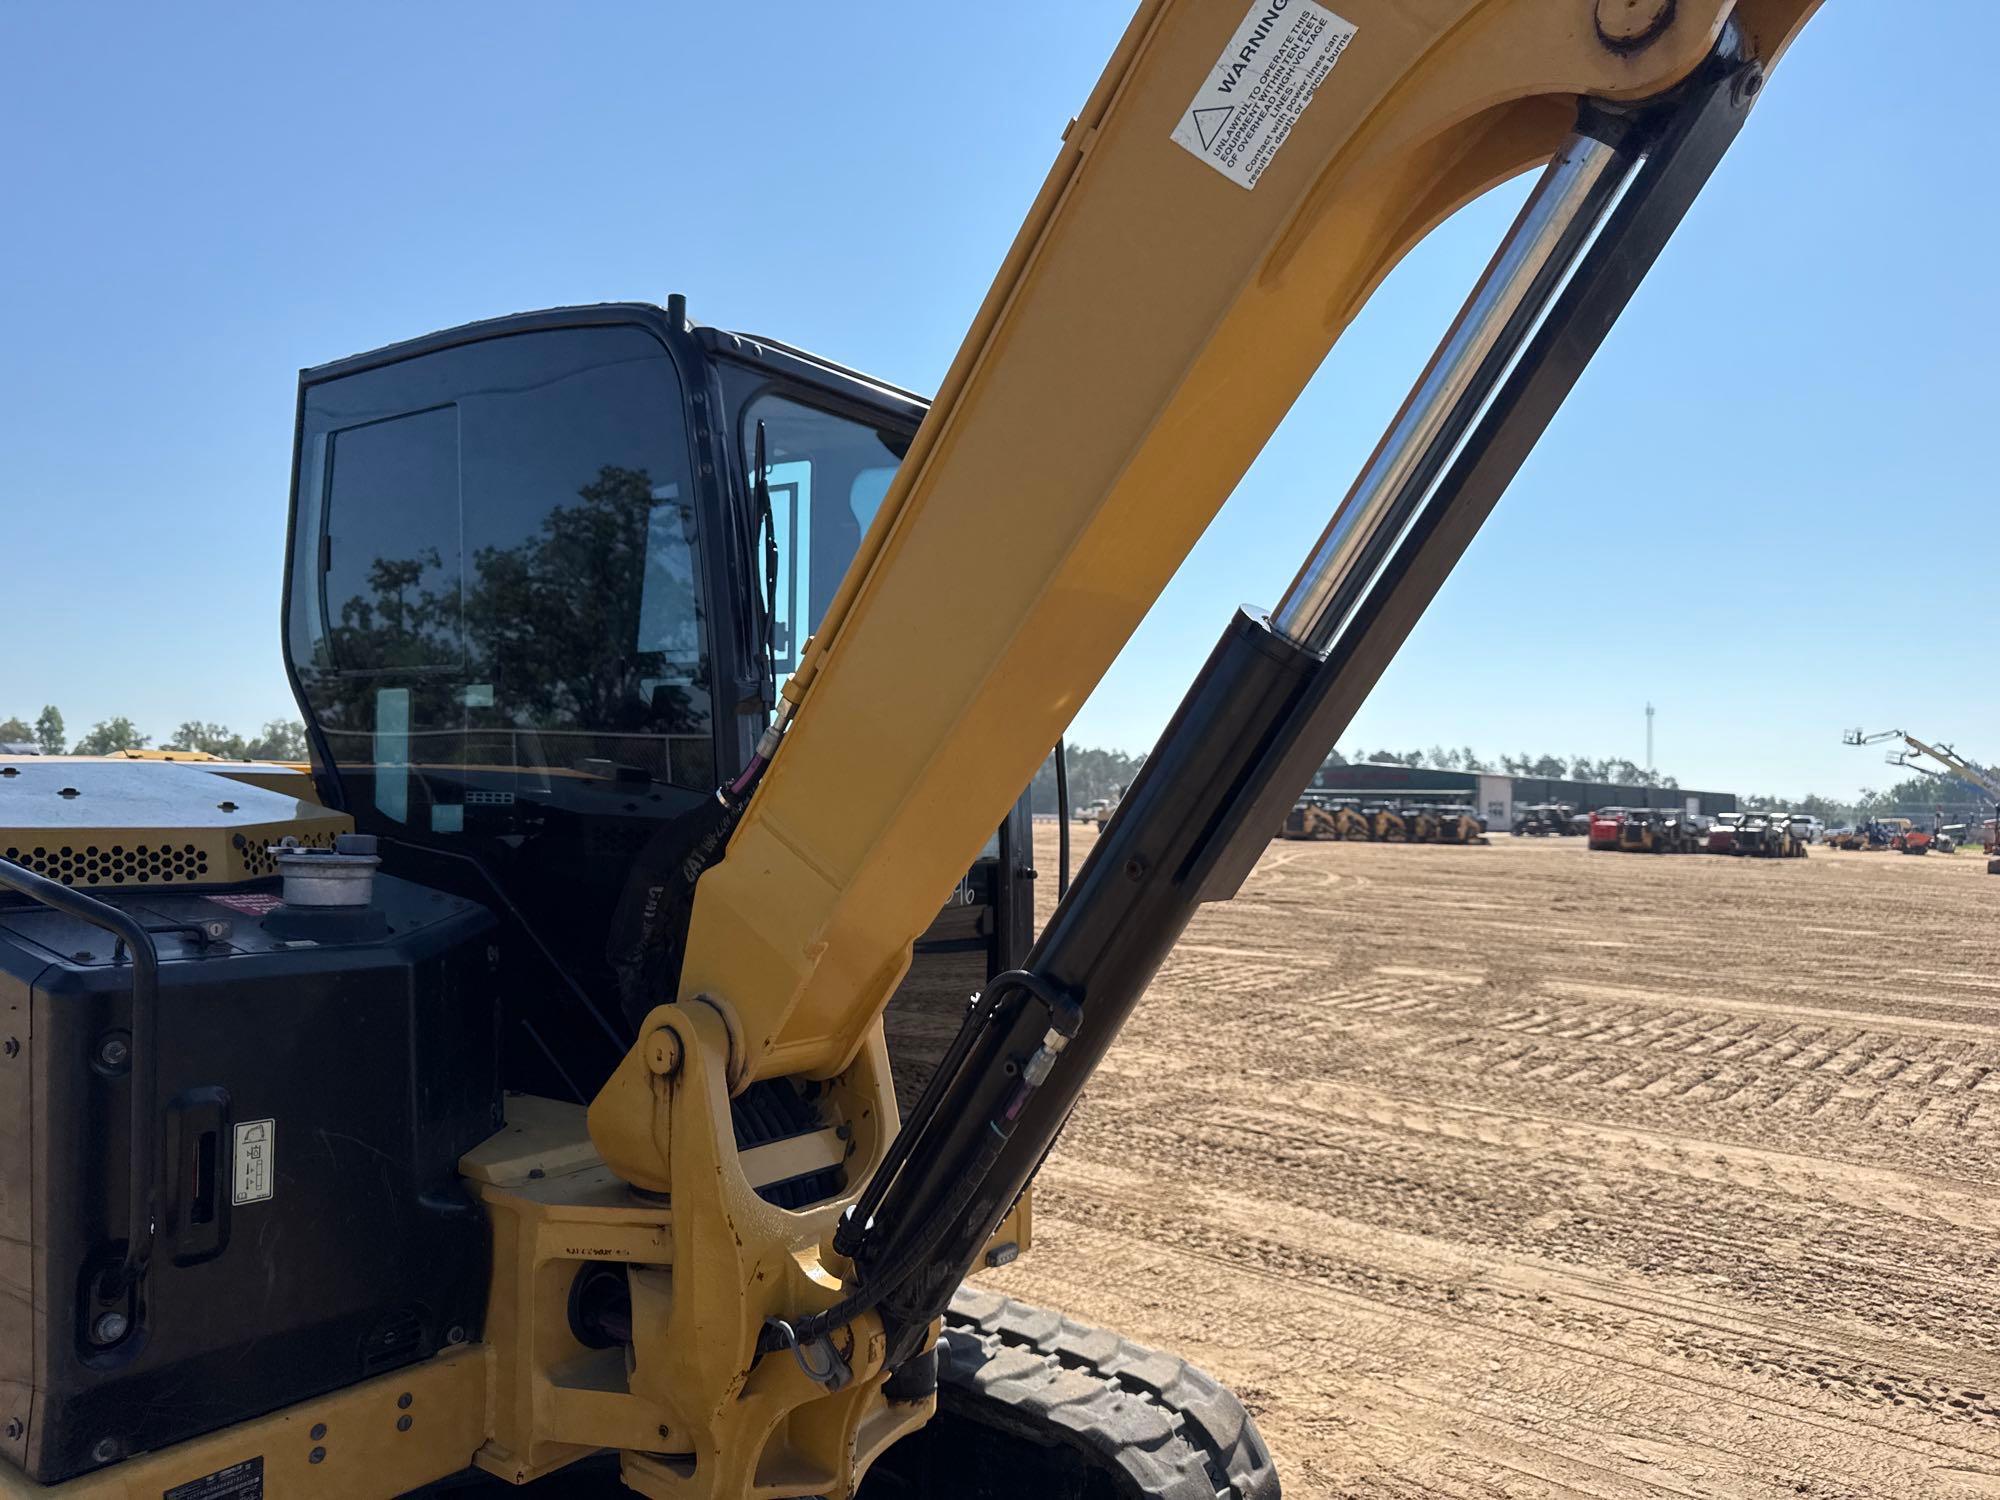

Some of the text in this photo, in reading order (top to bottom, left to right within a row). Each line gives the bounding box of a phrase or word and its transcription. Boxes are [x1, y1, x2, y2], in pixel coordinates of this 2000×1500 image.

[1213, 10, 1310, 156] UNLAWFUL TO OPERATE THIS
[1217, 0, 1288, 94] WARNING
[1220, 14, 1318, 162] EQUIPMENT WITHIN TEN FEET
[1226, 17, 1328, 168] OF OVERHEAD HIGH-VOLTAGE
[1245, 33, 1339, 172] Contact with power lines can
[1248, 32, 1351, 184] result in death or serious burns.
[1269, 87, 1293, 118] LINES
